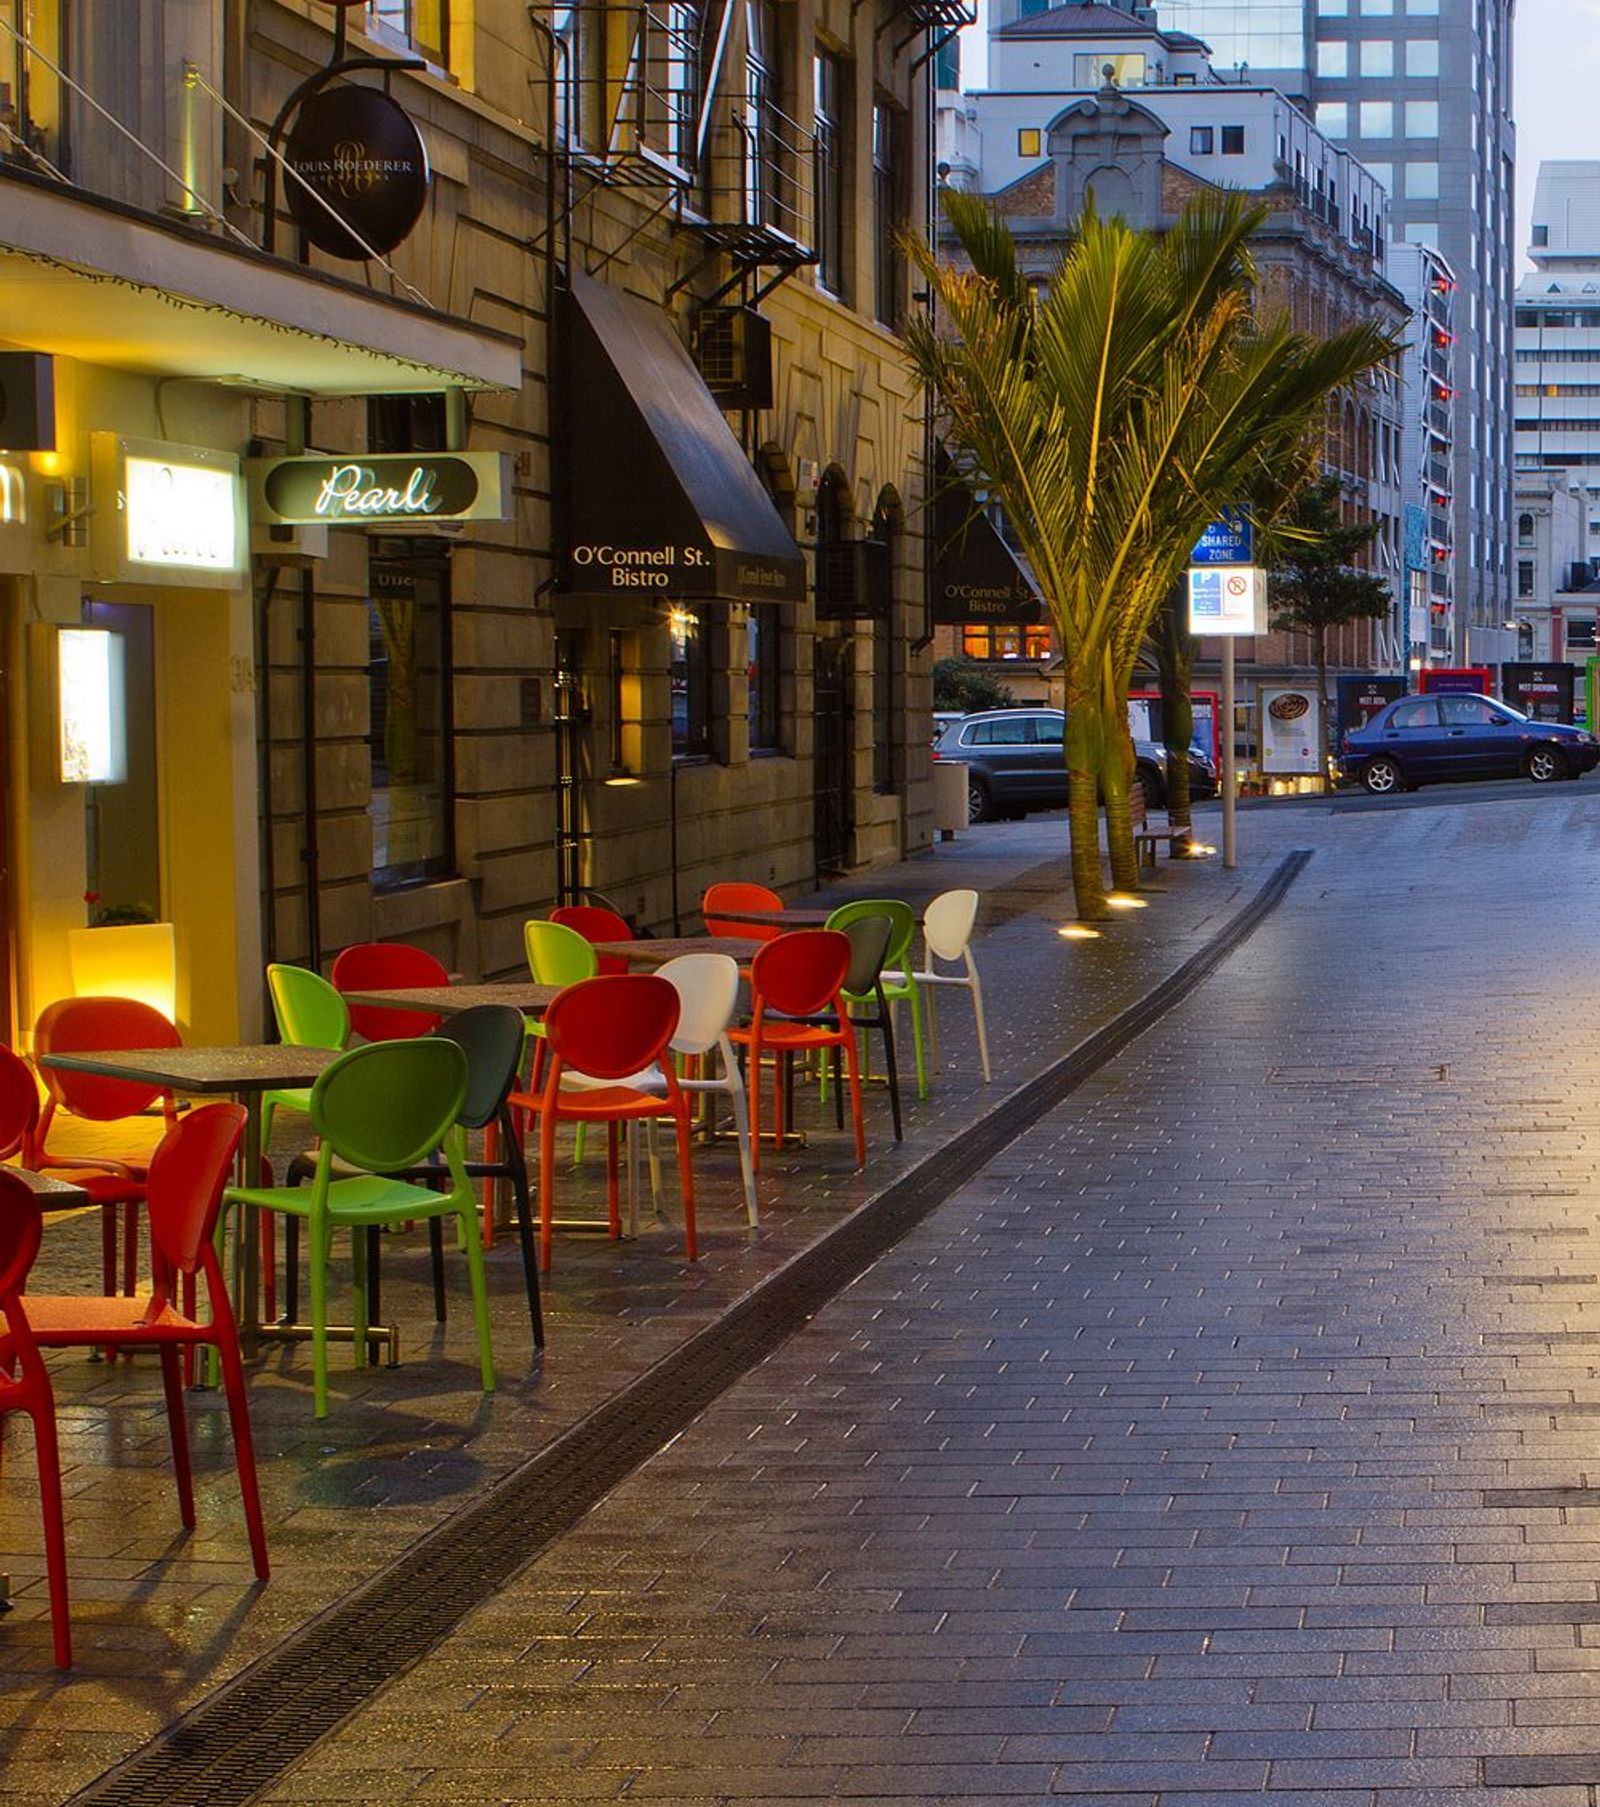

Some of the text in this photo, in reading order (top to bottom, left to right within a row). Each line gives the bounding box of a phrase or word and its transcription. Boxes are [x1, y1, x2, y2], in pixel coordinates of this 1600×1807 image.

[294, 158, 412, 172] LOUIS ROEDERER
[314, 464, 430, 514] Pearl
[1201, 535, 1241, 547] SHARED
[573, 546, 711, 567] O'Connell St.
[1209, 549, 1234, 560] ZONE
[612, 568, 669, 587] Bistro
[969, 600, 1007, 613] Bistro
